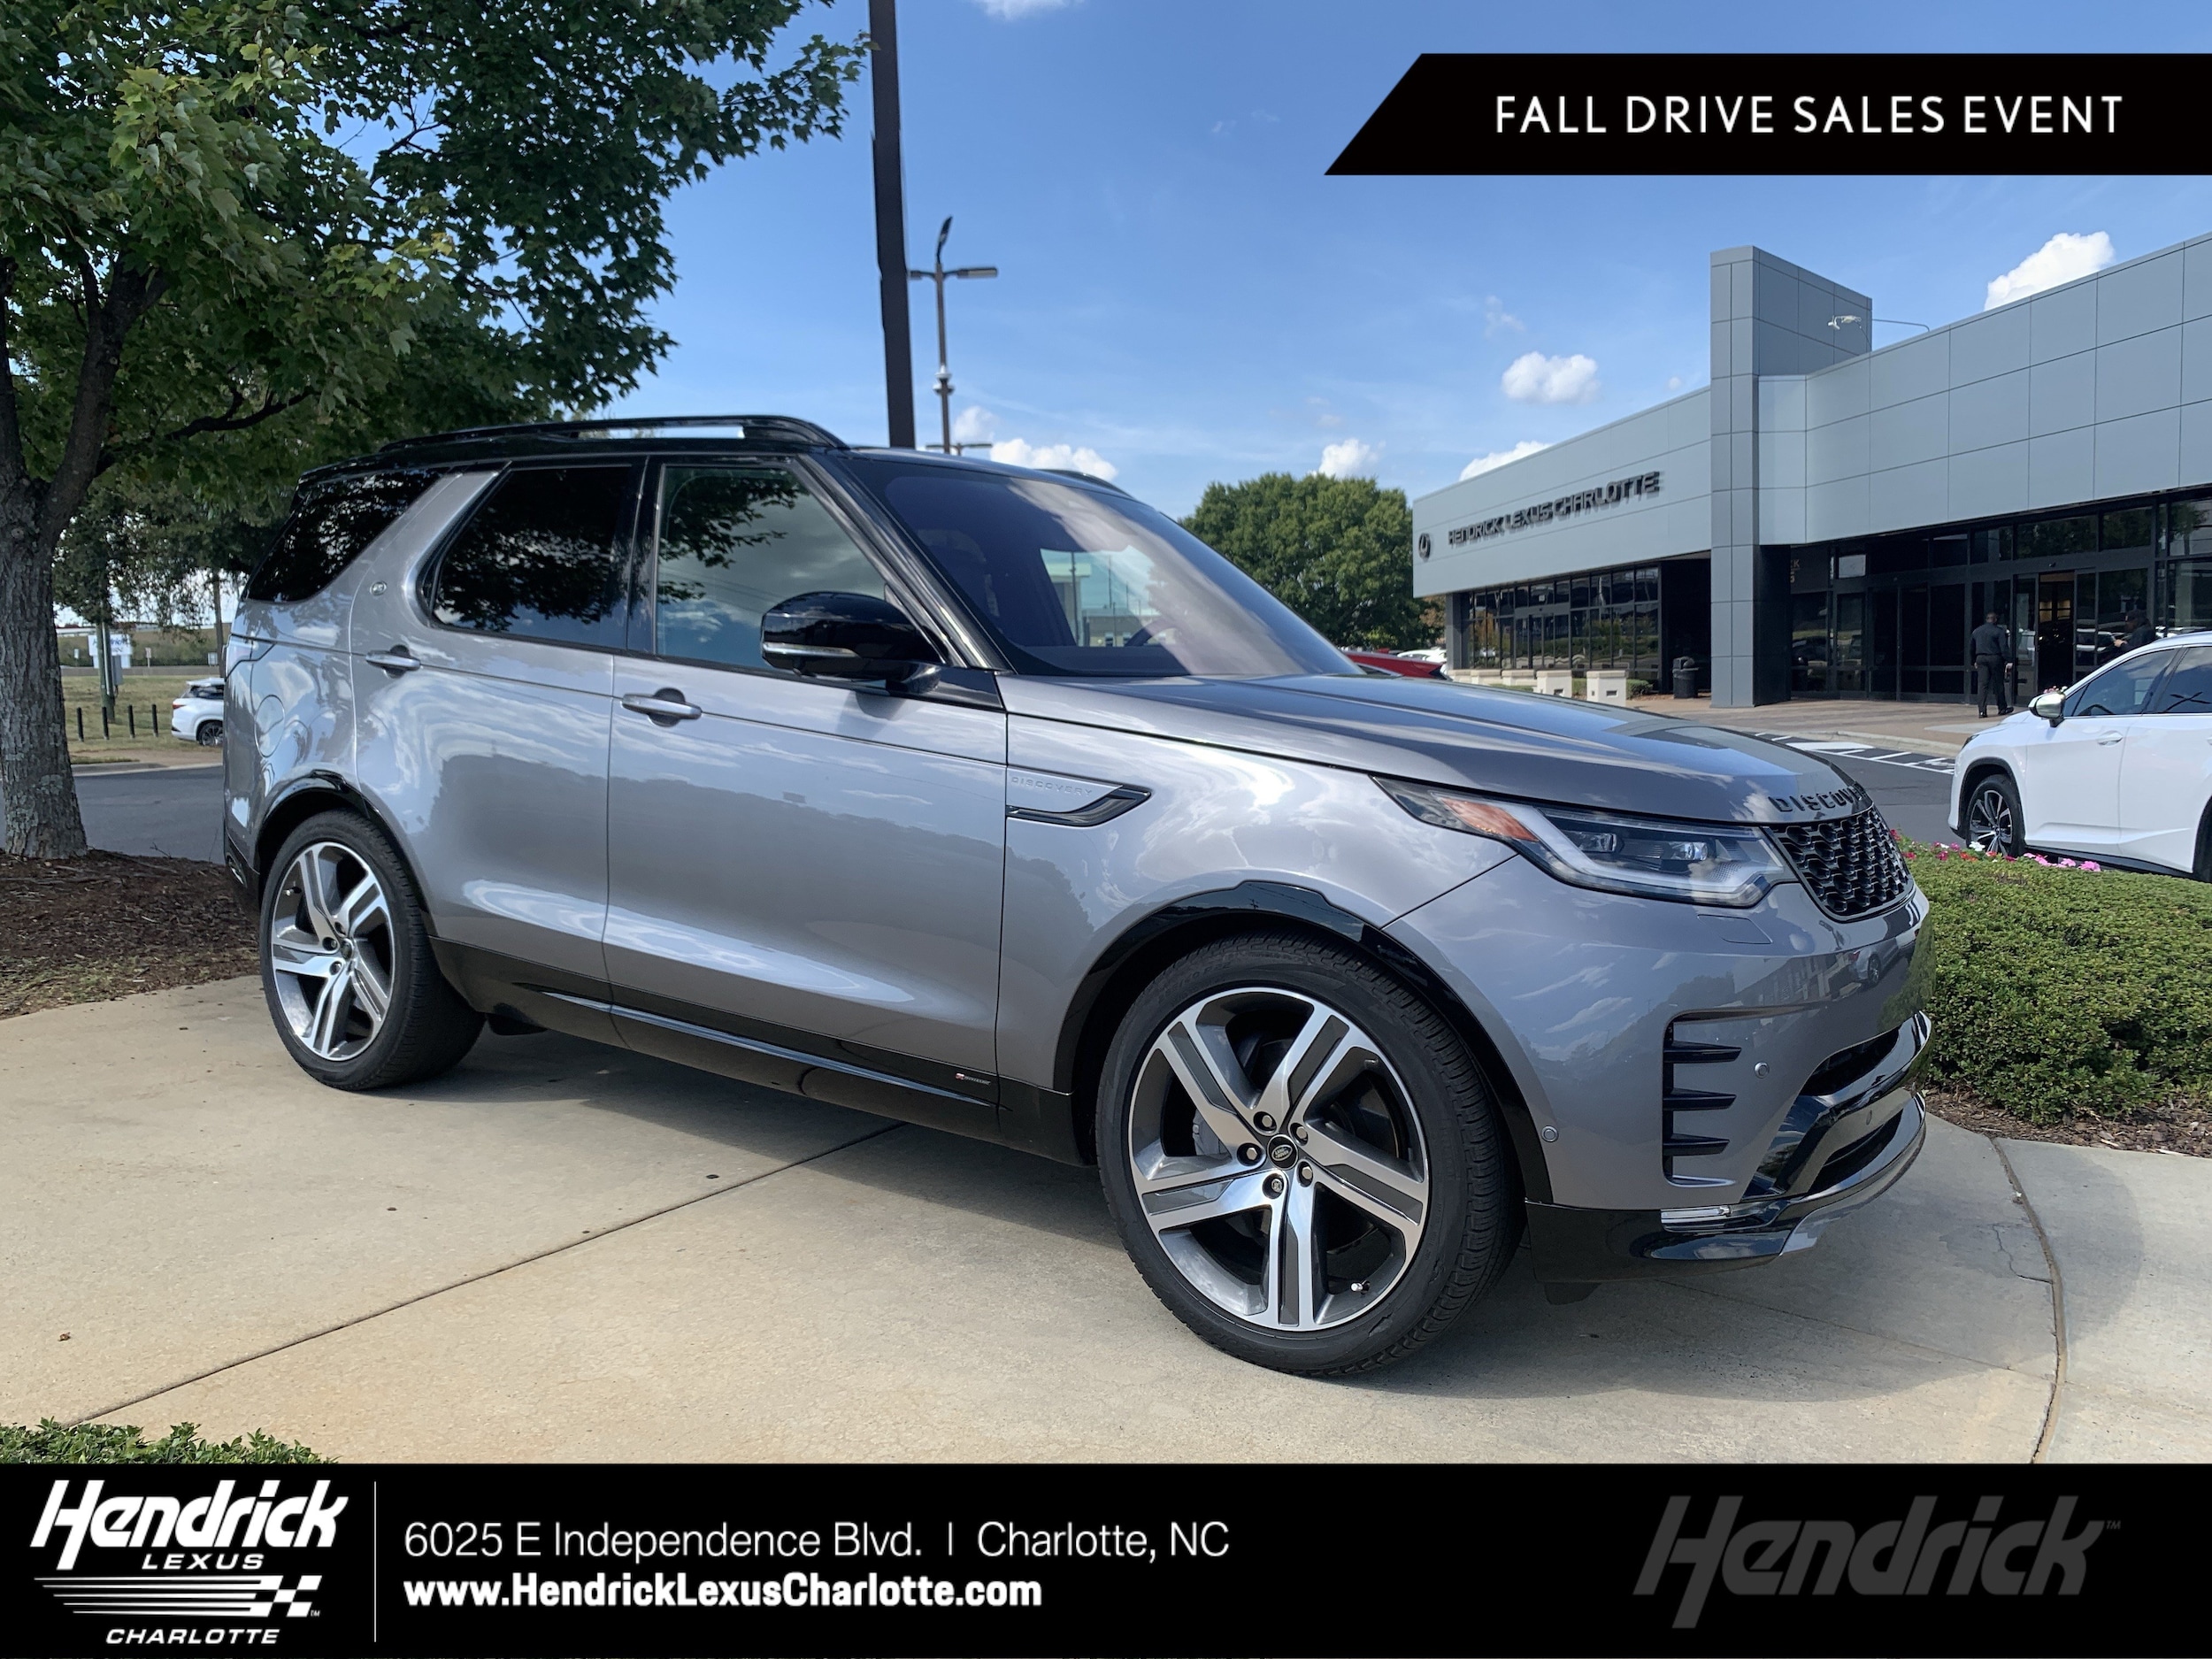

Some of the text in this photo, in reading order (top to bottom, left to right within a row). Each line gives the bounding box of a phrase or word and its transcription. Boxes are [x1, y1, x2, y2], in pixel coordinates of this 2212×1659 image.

[1448, 471, 1660, 545] HENDRICK LEXUS CHARLOTTE
[1011, 777, 1093, 796] DISCOVERY
